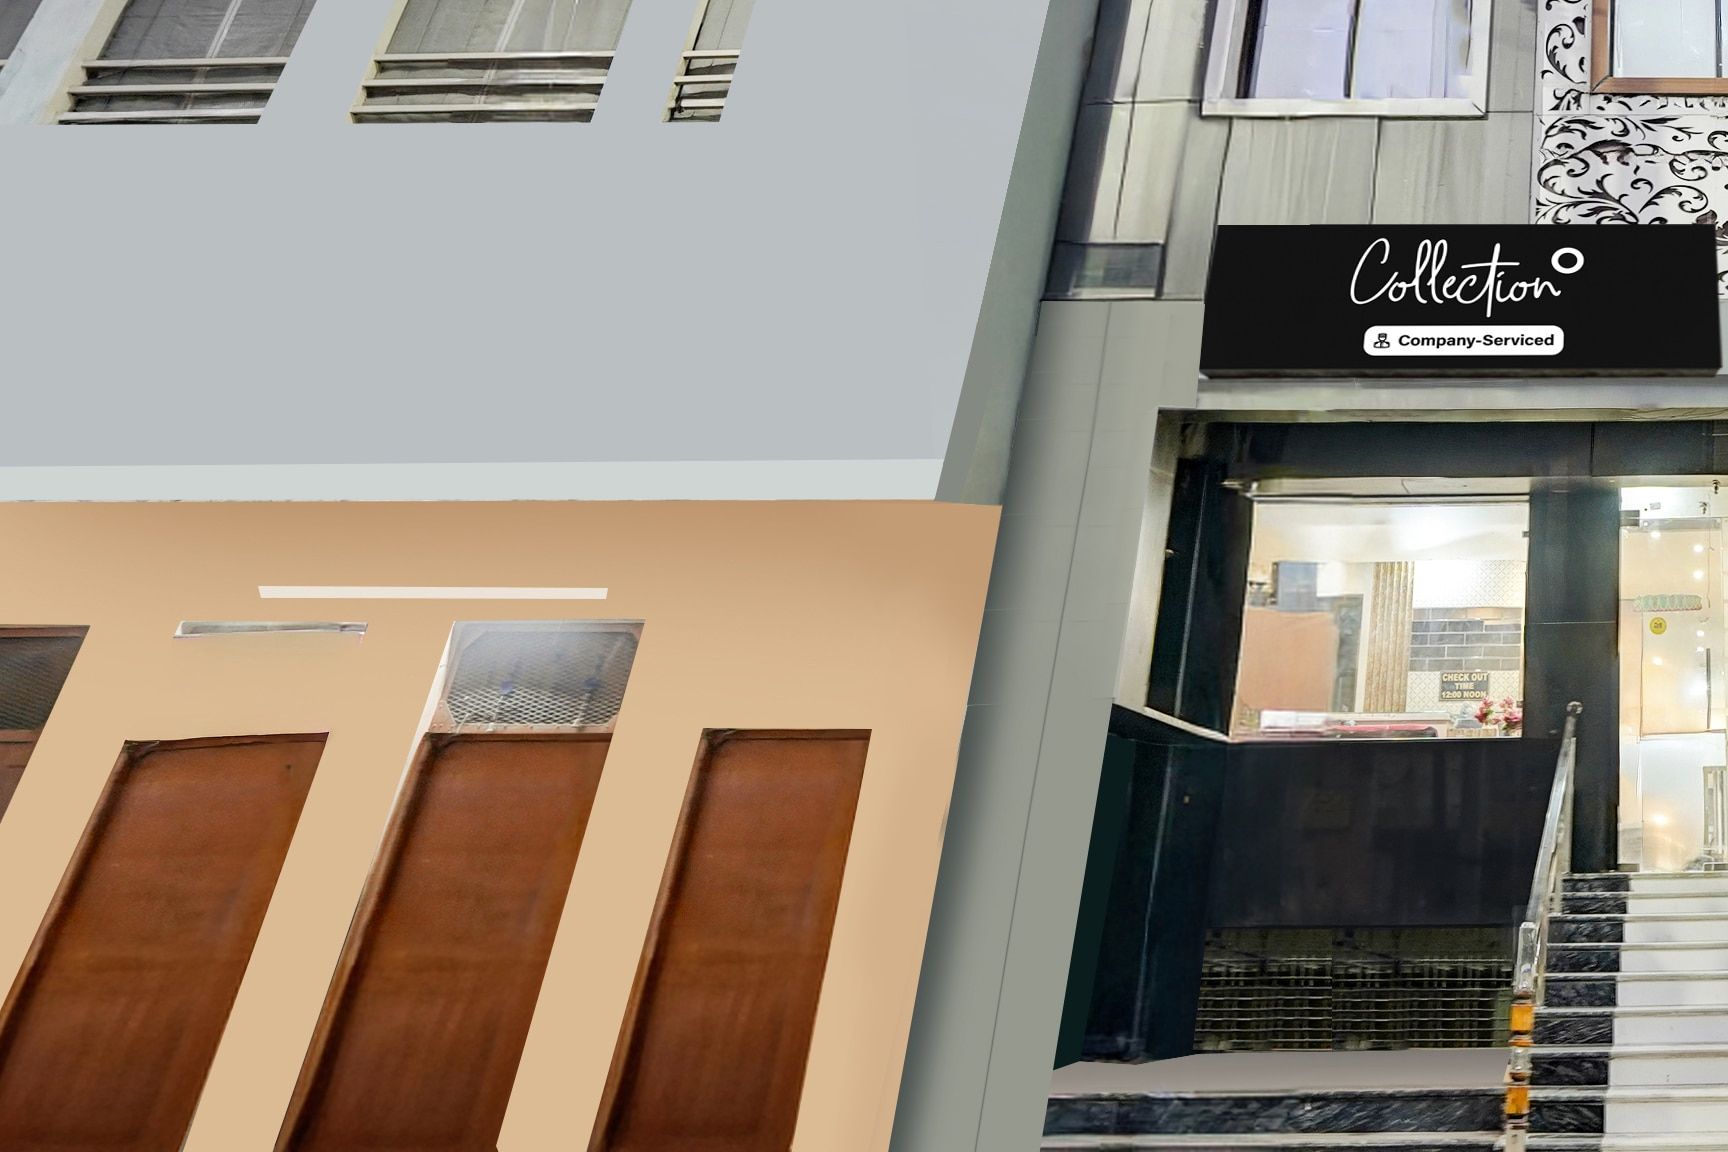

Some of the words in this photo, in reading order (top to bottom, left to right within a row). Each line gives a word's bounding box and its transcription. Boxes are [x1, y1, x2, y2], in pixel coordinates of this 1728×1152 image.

[1350, 237, 1562, 318] Collection
[1398, 333, 1555, 349] Company-Serviced
[1442, 673, 1469, 681] CHECK
[1471, 673, 1488, 681] OUT
[1455, 682, 1475, 690] TIME
